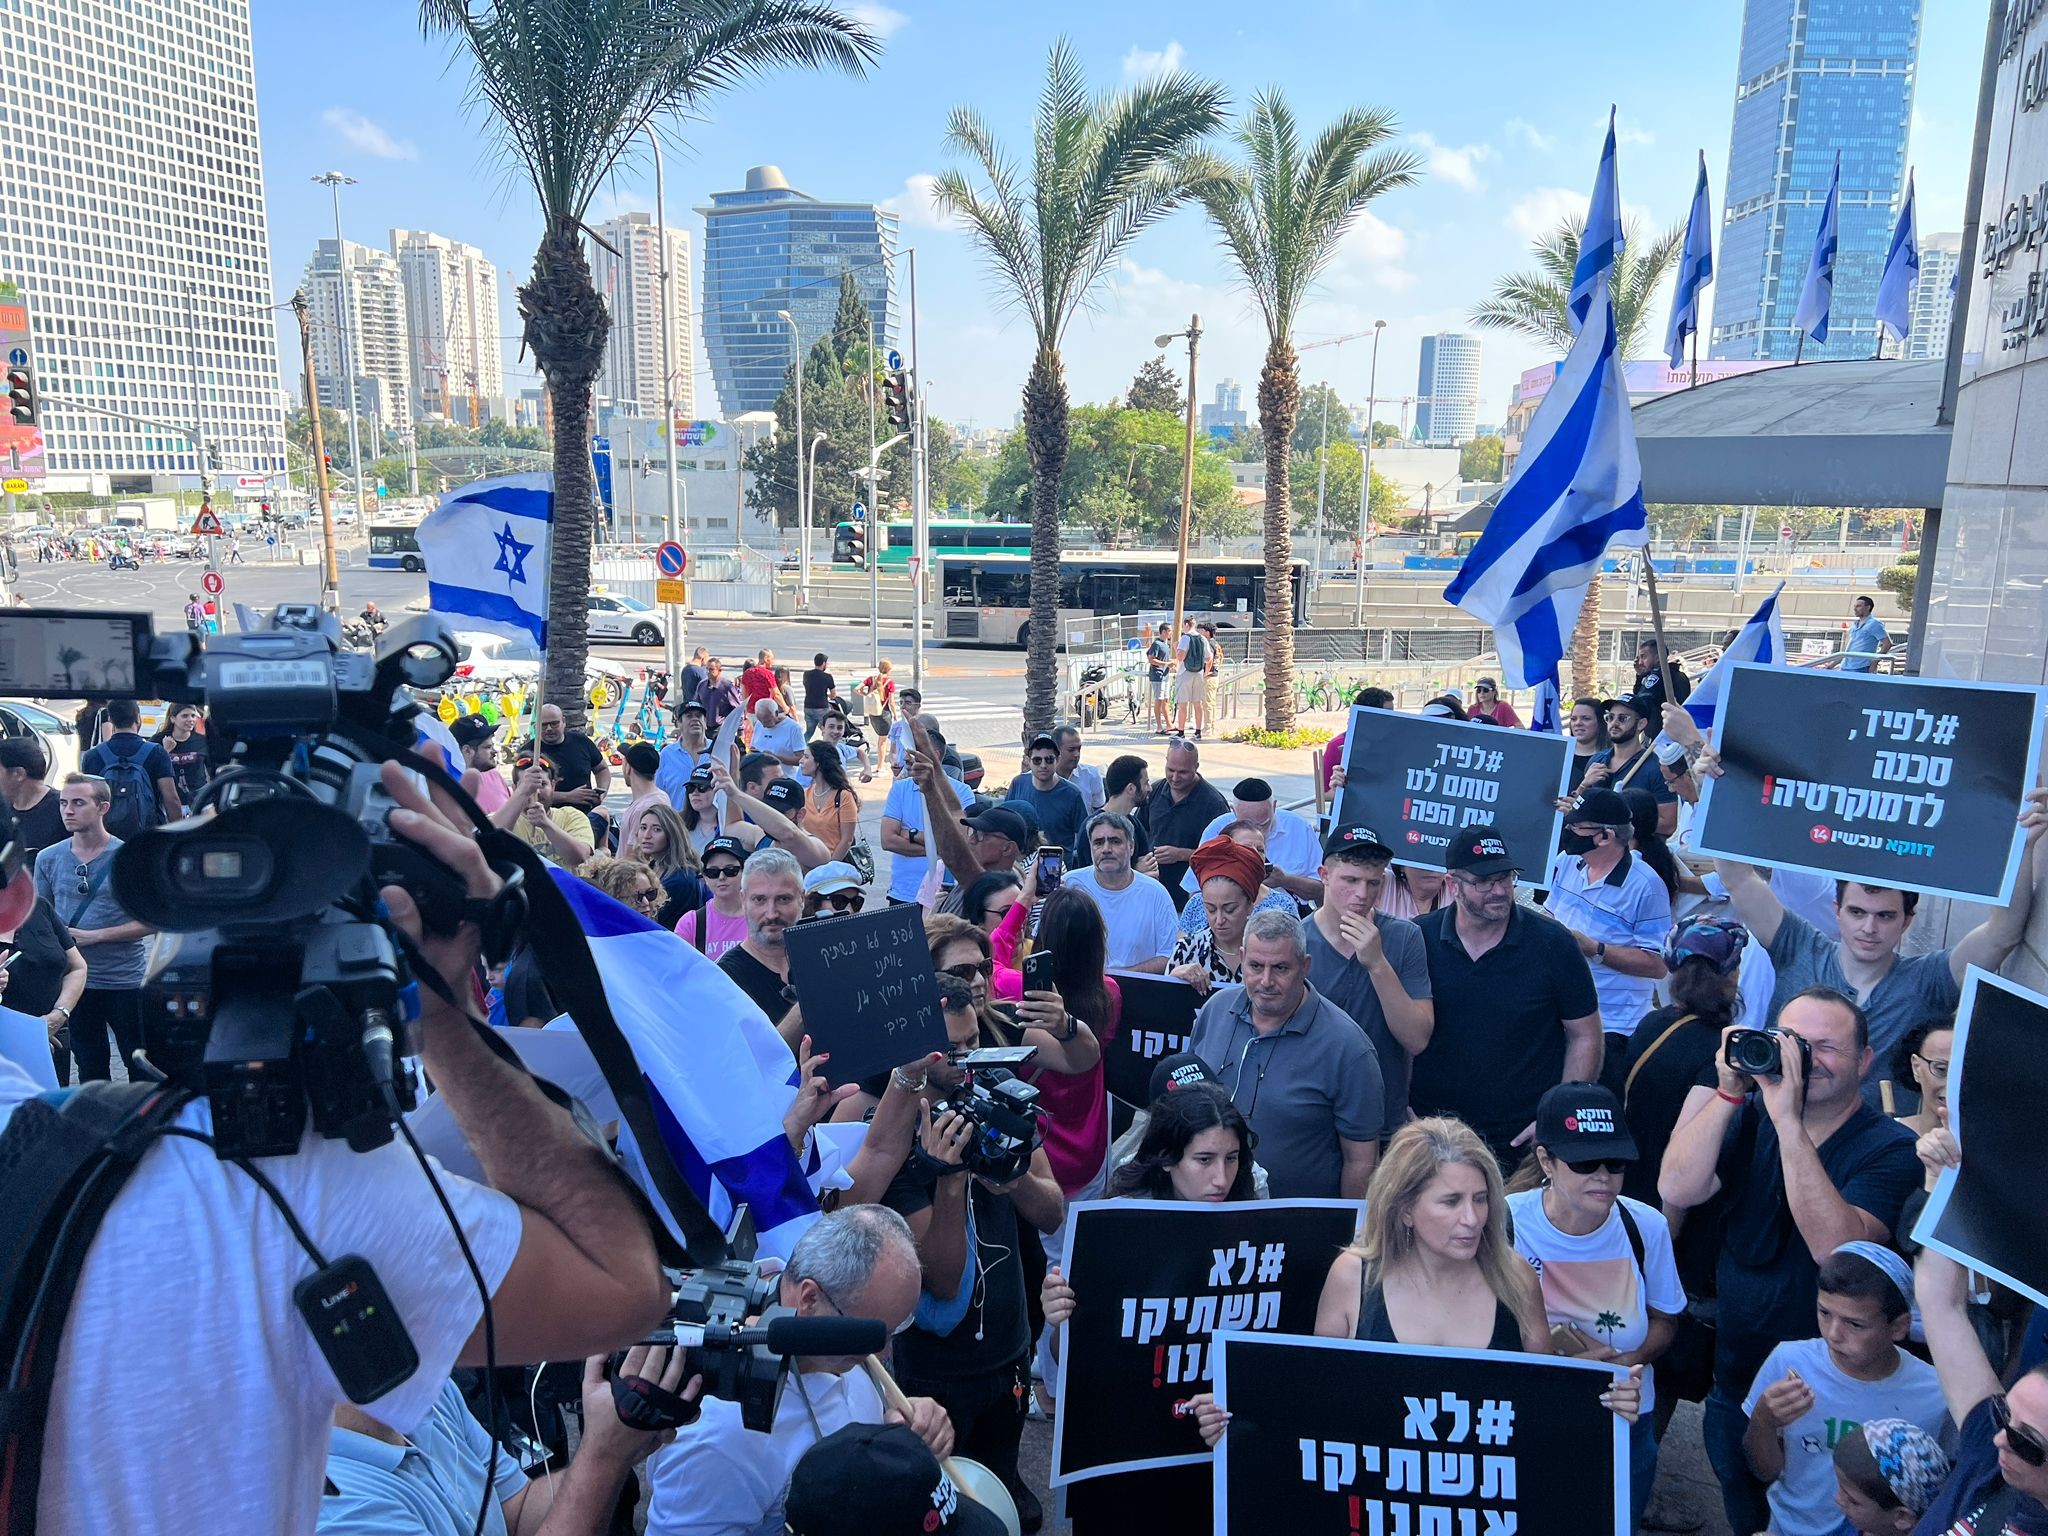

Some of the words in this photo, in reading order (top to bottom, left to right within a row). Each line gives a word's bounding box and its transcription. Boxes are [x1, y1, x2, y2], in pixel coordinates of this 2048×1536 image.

[1848, 708, 1959, 745] #לפיד,
[1433, 743, 1504, 773] #לפיד,
[1871, 750, 1954, 787] סכנה
[1405, 768, 1437, 793] לנו
[1442, 774, 1500, 803] סותם
[1402, 798, 1455, 827] הפה!
[1760, 775, 1945, 828] לדמוקרטיה!
[1460, 807, 1495, 829] את
[1408, 833, 1419, 842] 14
[1813, 828, 1828, 841] 14
[1831, 830, 1883, 849] עכשיו
[1885, 839, 1935, 857] דווקא
[867, 930, 880, 950] לא
[1131, 1029, 1191, 1059] יקו
[1170, 1063, 1200, 1080] דווקא
[1576, 1108, 1612, 1121] דווקא
[1577, 1121, 1615, 1133] עכשיו
[1208, 1240, 1285, 1287] #לא
[1121, 1291, 1281, 1345] תשתיקו
[1152, 1343, 1213, 1388] נו!
[1403, 1391, 1515, 1446] #לא
[1299, 1437, 1517, 1500] תשתיקו
[1348, 1495, 1517, 1536] אותנו!
